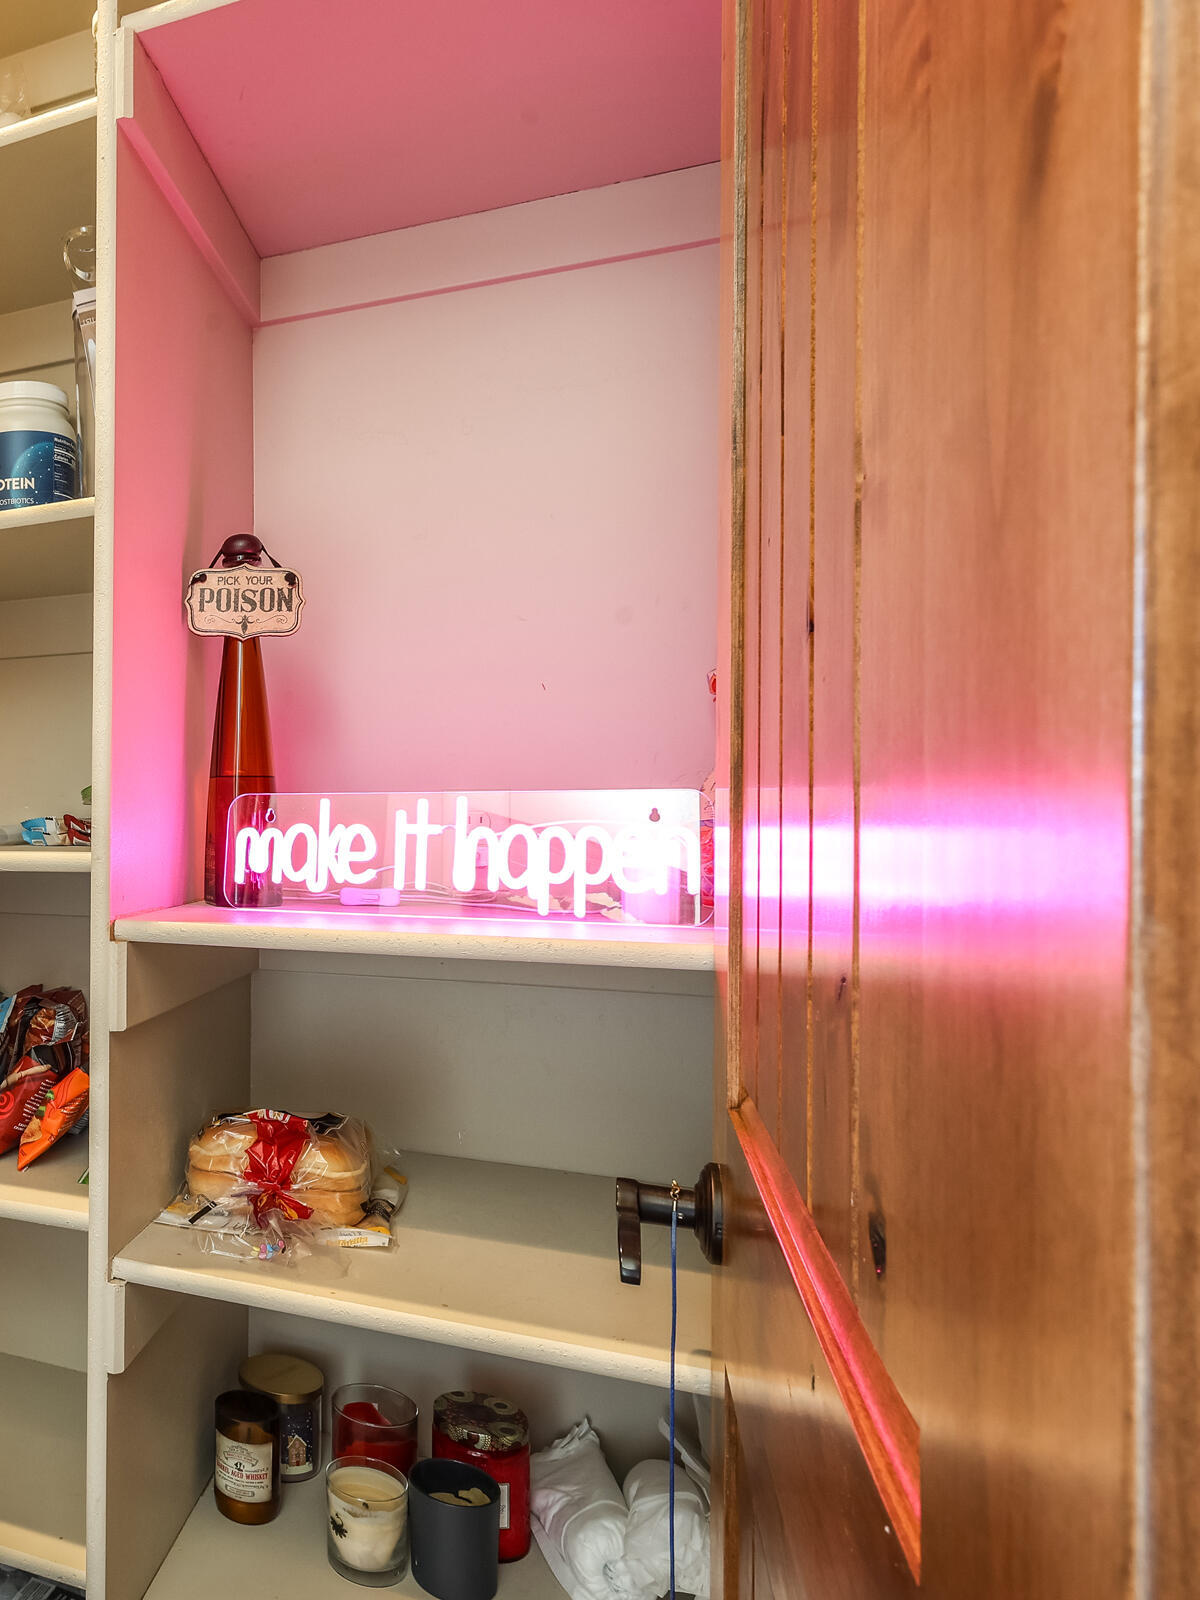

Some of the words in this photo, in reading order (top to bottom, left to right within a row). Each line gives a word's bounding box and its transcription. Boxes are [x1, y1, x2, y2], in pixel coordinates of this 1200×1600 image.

[217, 576, 240, 586] PICK
[246, 576, 273, 586] YOUR
[198, 587, 293, 613] POISON
[233, 797, 378, 893] make
[452, 796, 699, 918] happen
[245, 1472, 268, 1480] WHISKEY
